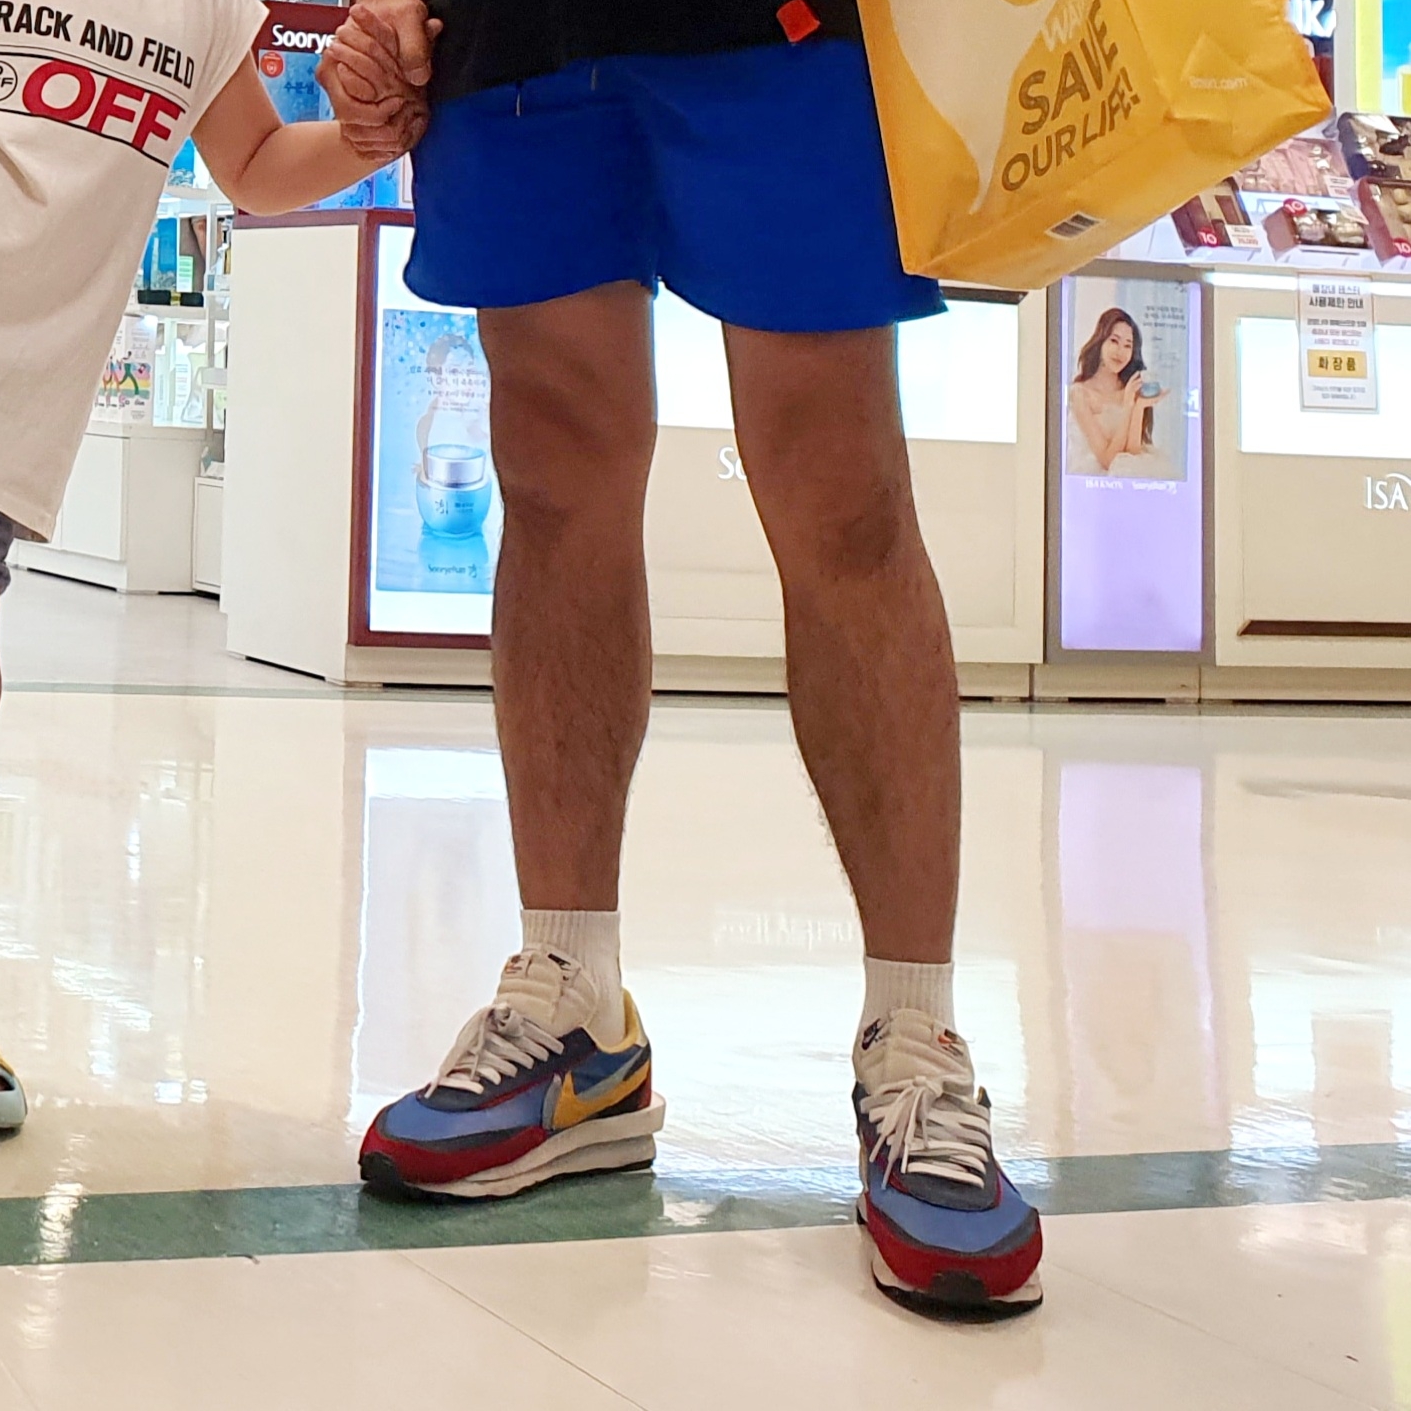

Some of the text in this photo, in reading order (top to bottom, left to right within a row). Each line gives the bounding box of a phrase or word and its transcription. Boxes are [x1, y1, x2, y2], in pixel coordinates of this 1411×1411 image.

[79, 18, 134, 62] AND
[138, 36, 196, 90] FIELD
[21, 59, 182, 151] OFF
[1001, 125, 1076, 191] OUR
